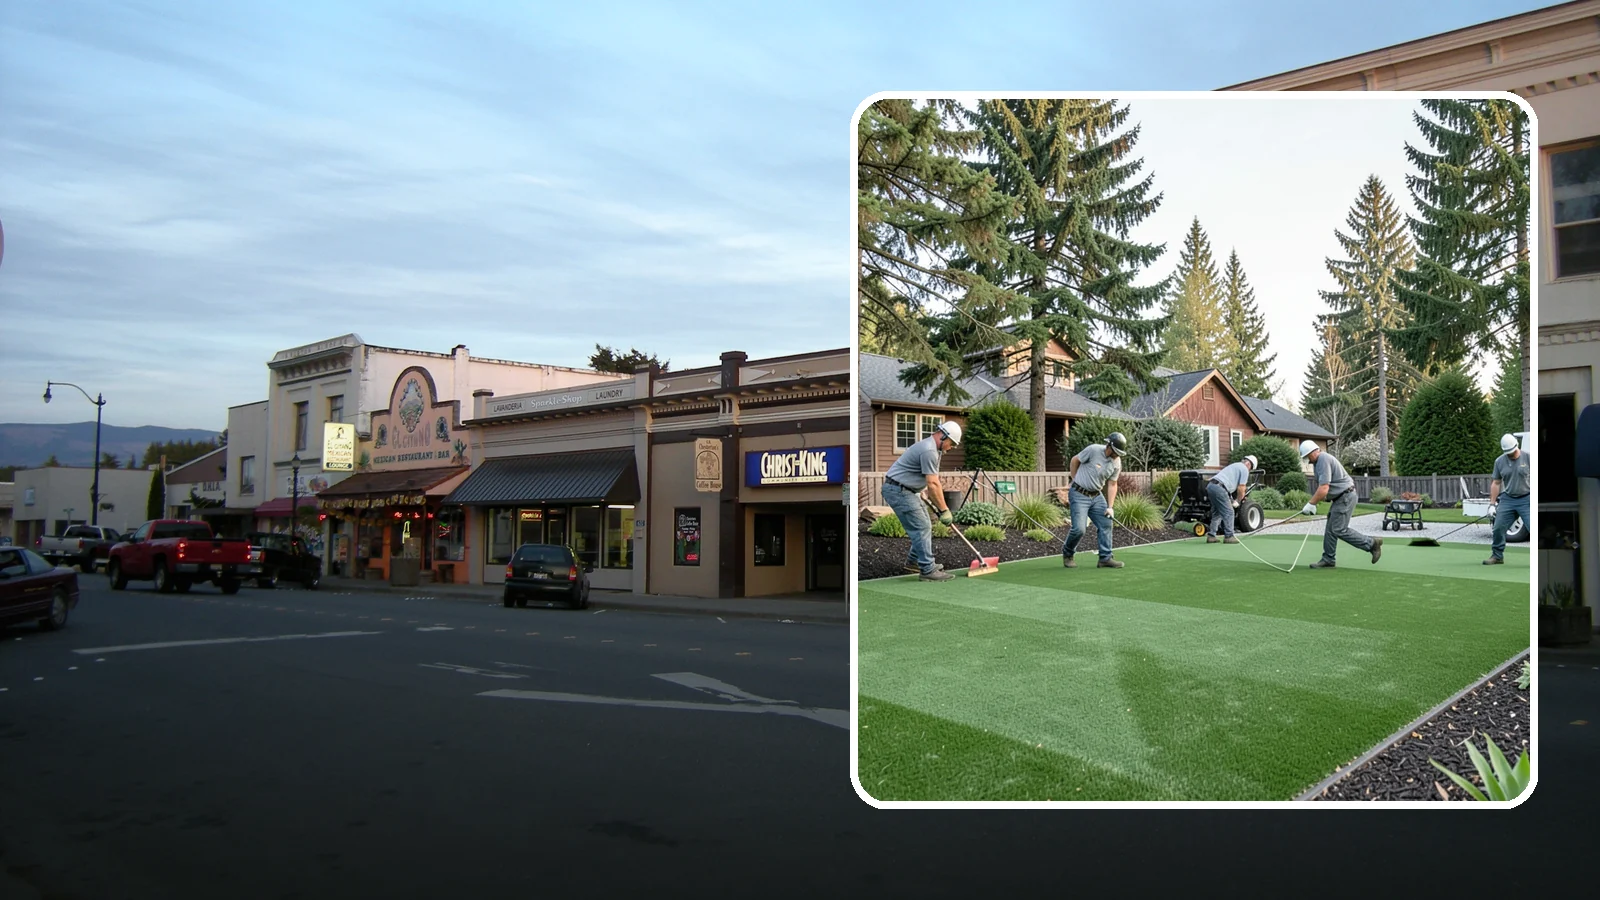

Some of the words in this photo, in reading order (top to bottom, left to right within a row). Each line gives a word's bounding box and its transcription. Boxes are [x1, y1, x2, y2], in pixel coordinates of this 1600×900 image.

[530, 398, 559, 409] Sparkle
[560, 394, 582, 405] Shop
[595, 389, 623, 400] LAUNDRY
[493, 402, 523, 413] LAVANDERIA
[373, 454, 397, 464] MEXICAN
[397, 451, 434, 462] RESTAURANT
[437, 450, 450, 459] BAR
[760, 452, 797, 478] CHRIST
[799, 450, 828, 476] KING
